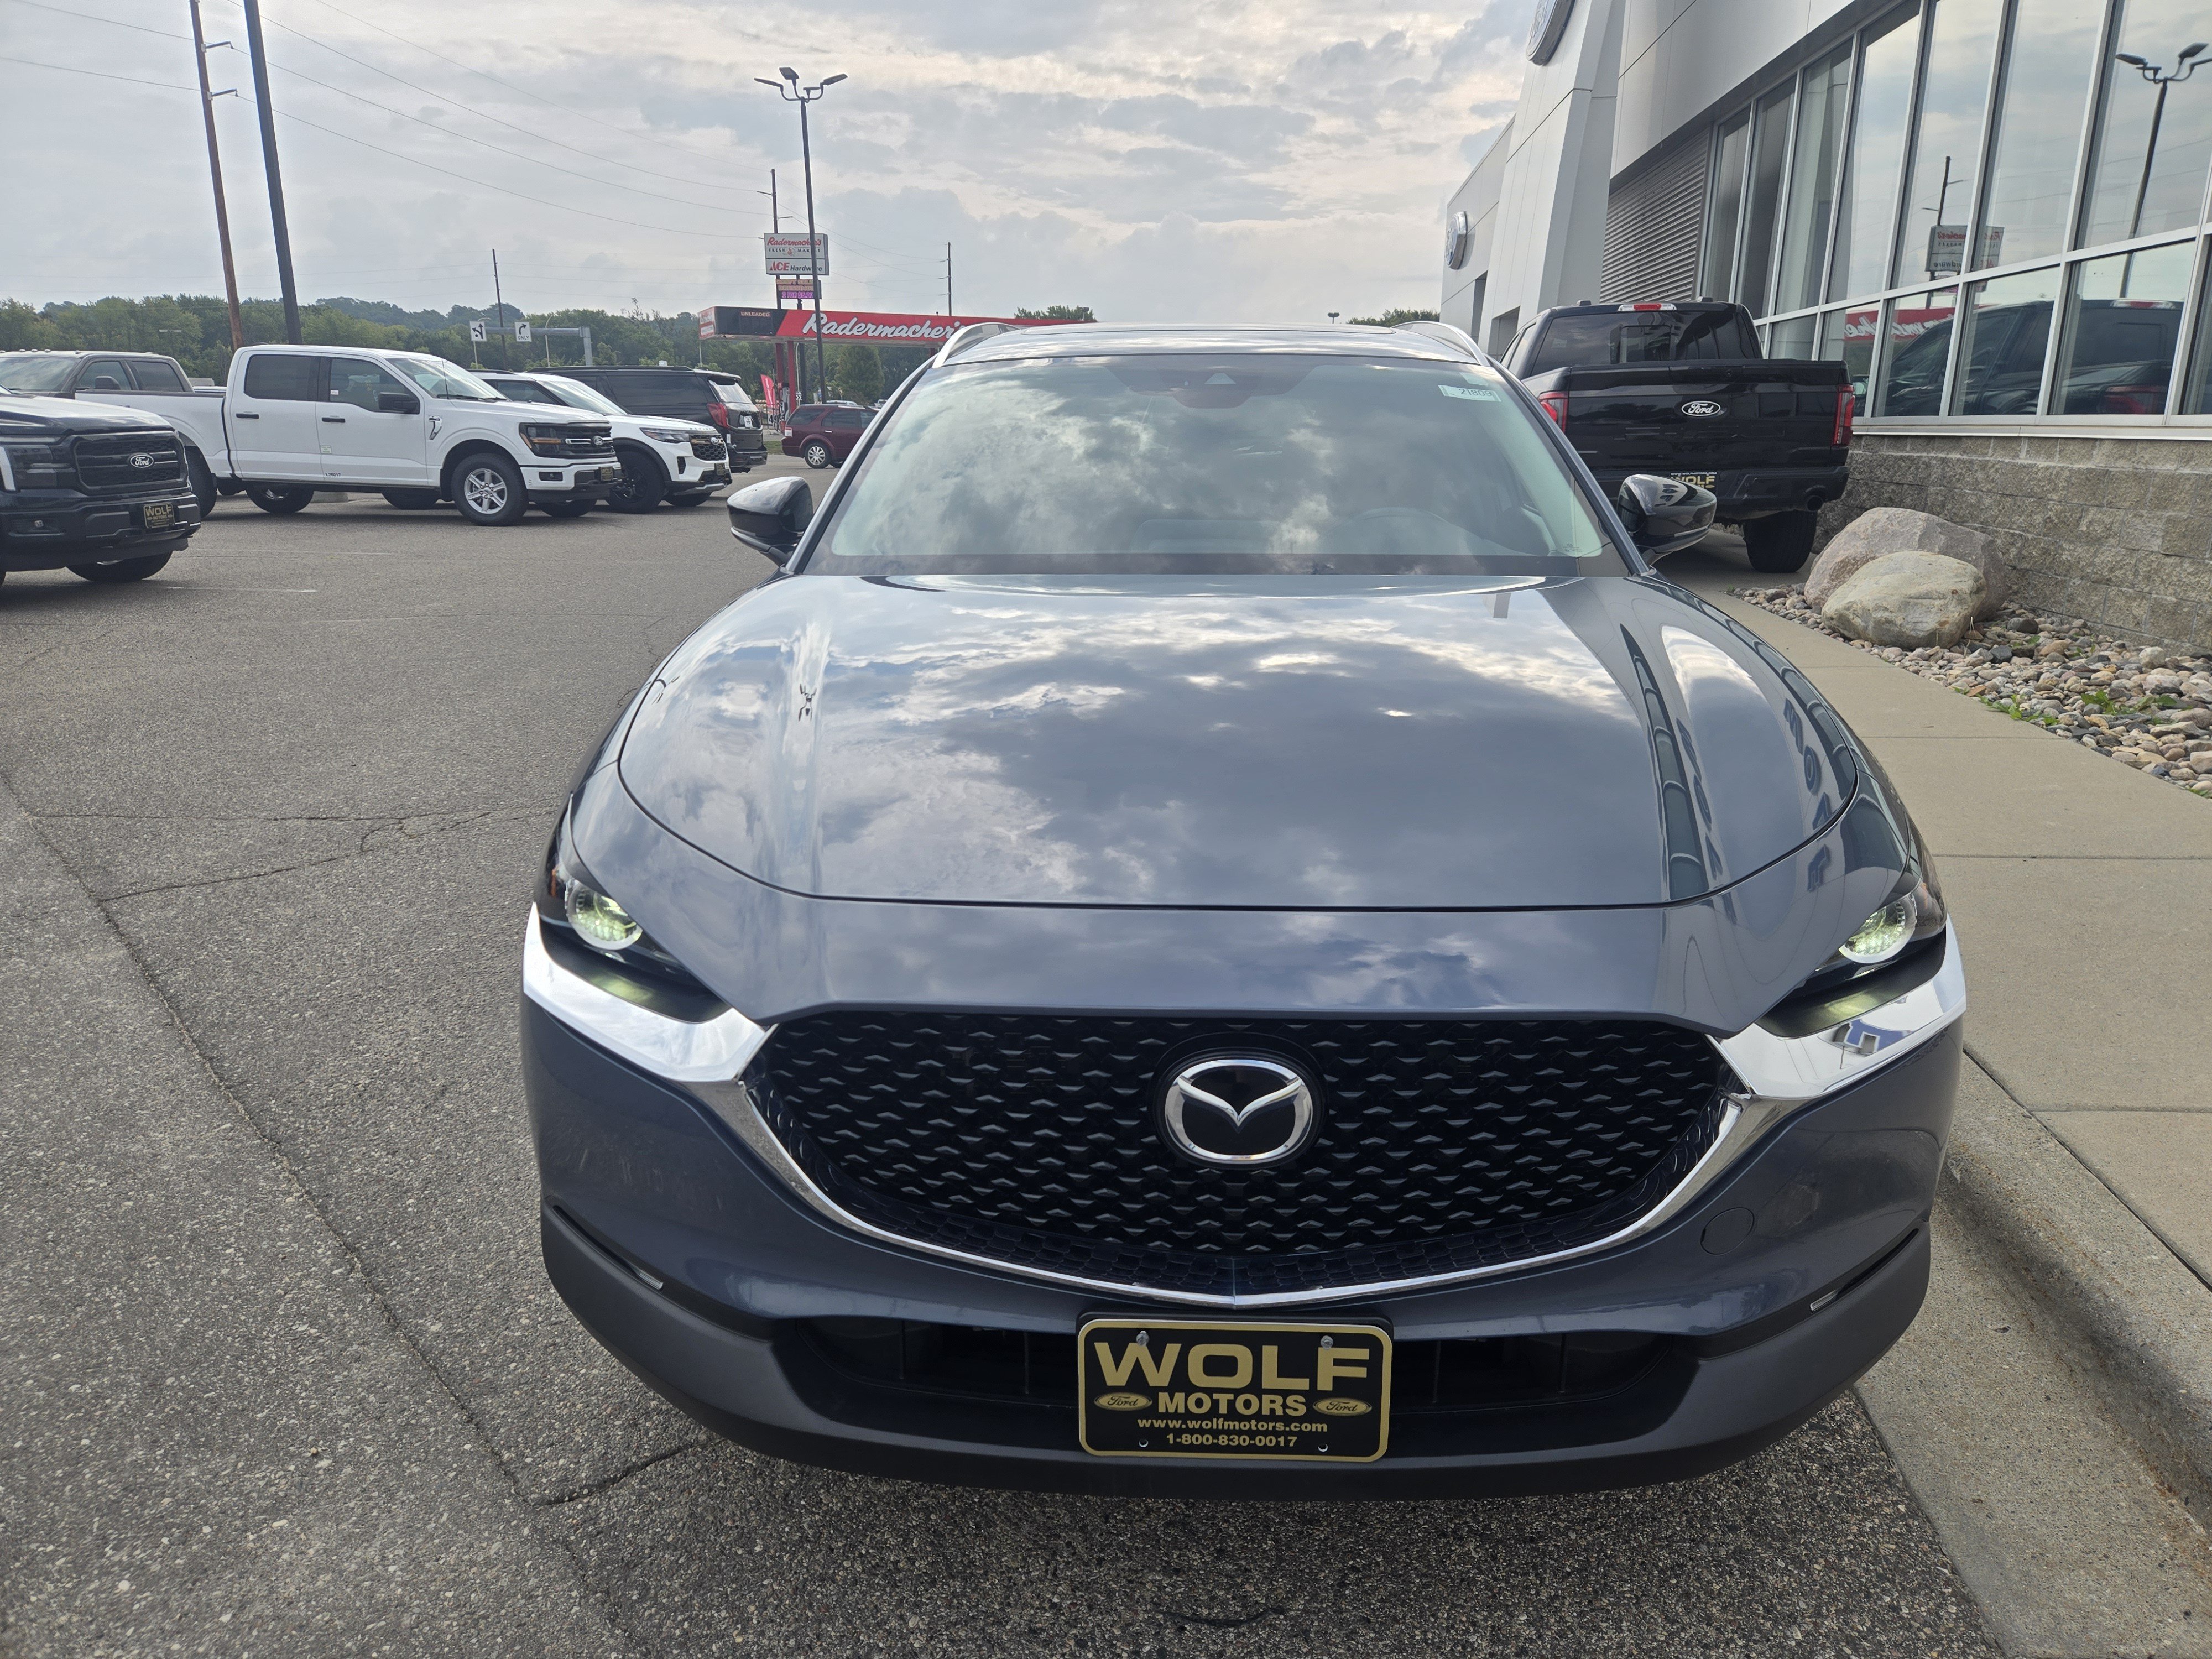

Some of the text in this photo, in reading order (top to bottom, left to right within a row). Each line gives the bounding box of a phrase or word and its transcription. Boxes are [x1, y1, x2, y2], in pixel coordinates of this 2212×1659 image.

[767, 237, 822, 246] Radermachr's
[769, 261, 790, 271] ACE
[802, 312, 966, 339] Radermacher'
[1459, 388, 1493, 397] 21809
[1688, 403, 1714, 414] Ford
[145, 506, 172, 517] WOLF
[1094, 1342, 1370, 1391] WOLF
[1158, 1392, 1307, 1417] MOTORS
[1137, 1418, 1327, 1432] www.wolfmotors.com
[1167, 1433, 1298, 1447] 1-800-830-0017
